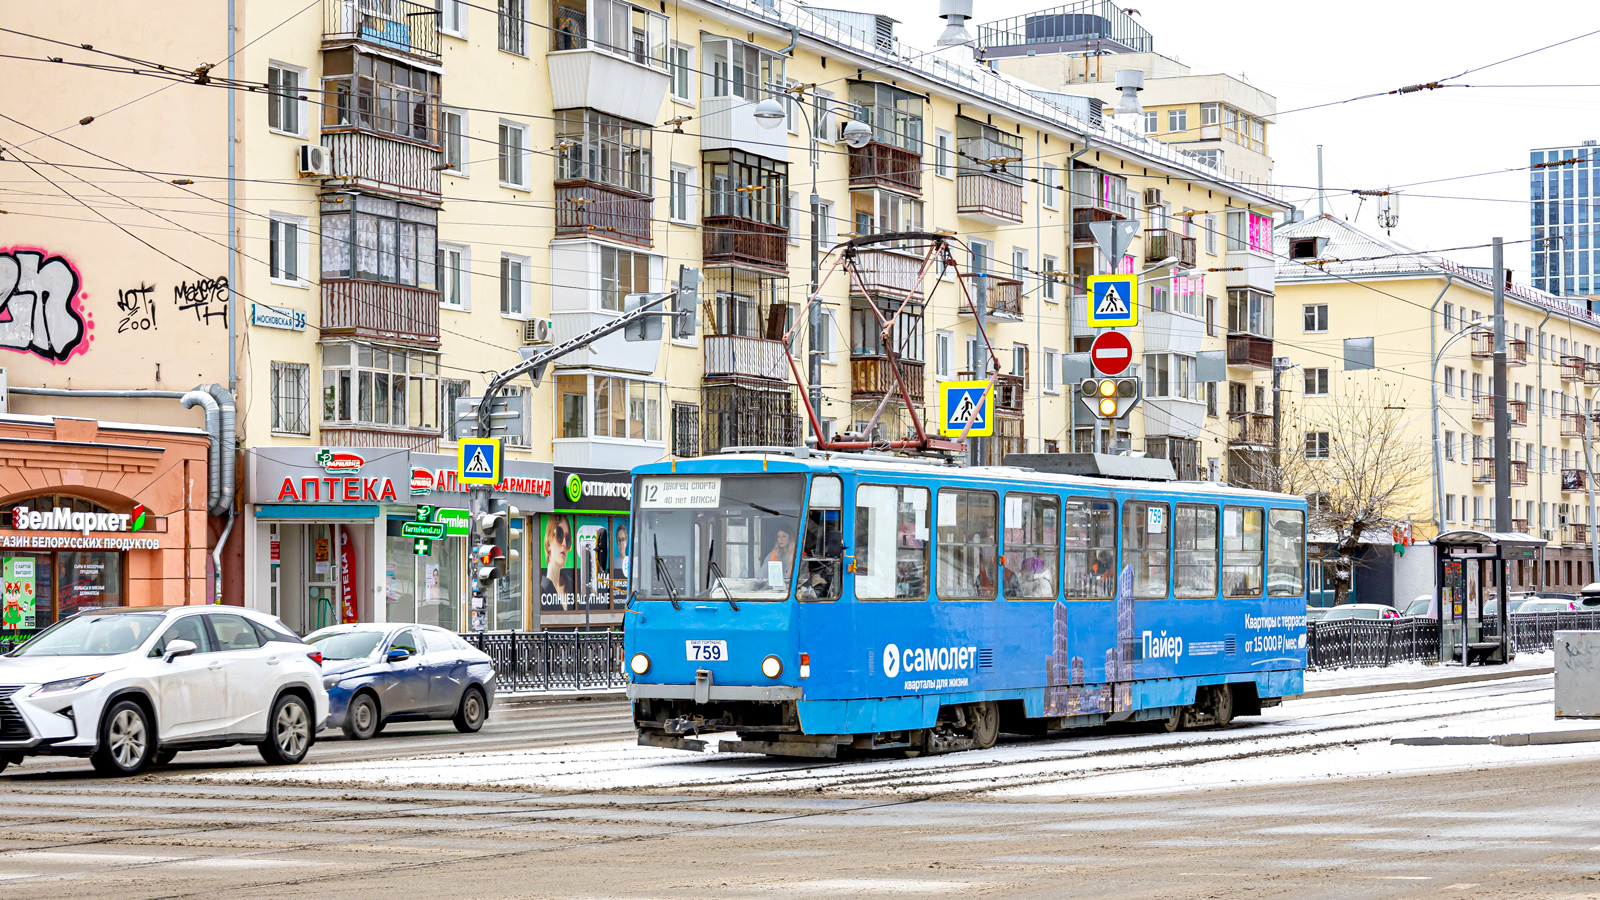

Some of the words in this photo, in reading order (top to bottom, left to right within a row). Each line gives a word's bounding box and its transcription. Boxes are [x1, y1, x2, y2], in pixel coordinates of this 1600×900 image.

[257, 315, 292, 326] МОСКОВСКАЯ
[295, 312, 306, 328] 35
[277, 476, 398, 501] АПТЕКА
[644, 484, 659, 502] 12
[663, 496, 673, 504] 40
[690, 495, 717, 504] ВЛКСМ
[14, 506, 130, 536] БелМаркет
[1149, 508, 1162, 523] 759
[31, 536, 102, 549] БЕЛОРУССКИХ
[103, 537, 160, 551] ПРОДУКТОВ
[341, 552, 354, 617] АПТЕКА
[1244, 613, 1277, 632] Квартиры
[1277, 616, 1281, 628] с
[692, 645, 721, 660] 759
[1142, 629, 1183, 664] Пайер
[1245, 640, 1253, 653] от
[1254, 636, 1263, 652] 15
[1263, 635, 1277, 652] 000
[903, 646, 977, 672] самолет
[904, 679, 936, 693] кварталы
[935, 678, 949, 690] для
[949, 677, 969, 687] жизни
